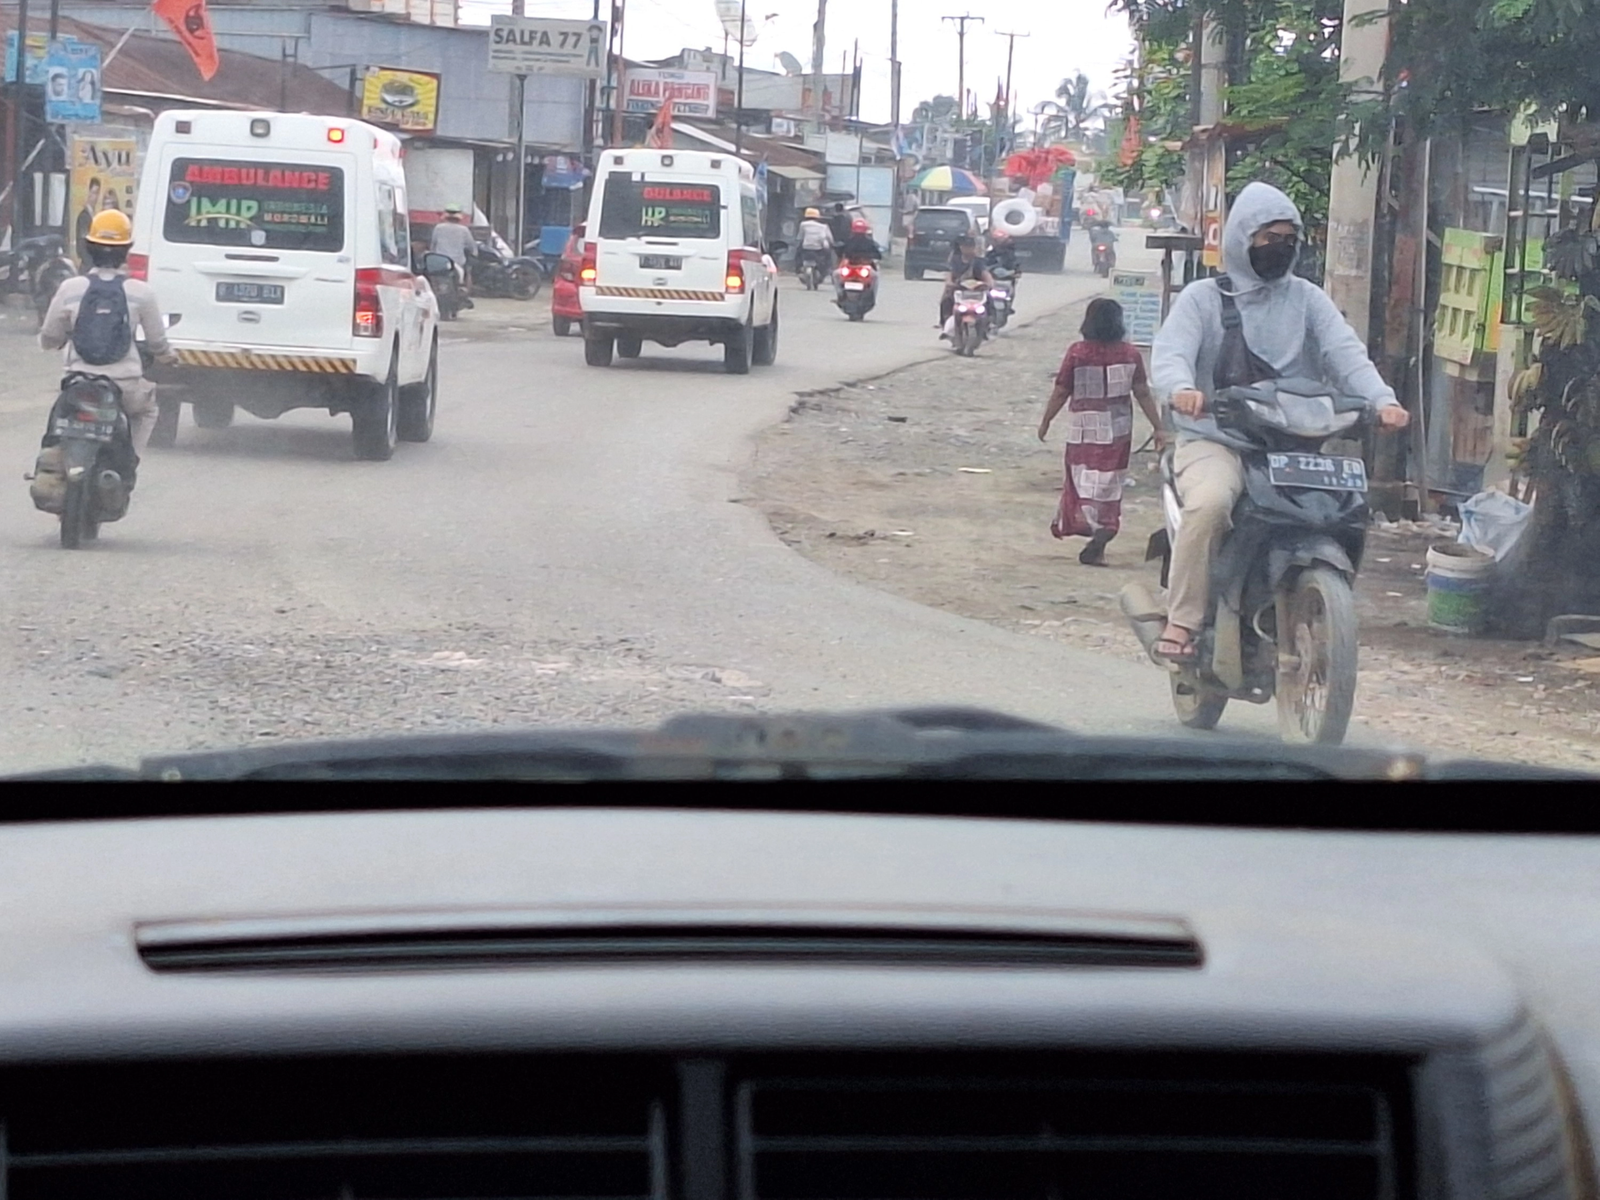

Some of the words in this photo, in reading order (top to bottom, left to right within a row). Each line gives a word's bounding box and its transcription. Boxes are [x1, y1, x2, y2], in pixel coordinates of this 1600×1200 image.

[493, 28, 551, 47] SALFA
[558, 31, 583, 50] 77
[80, 145, 131, 172] Ayu
[185, 164, 331, 190] AMBULANCE
[189, 197, 259, 229] IMIP
[1271, 455, 1289, 469] DP
